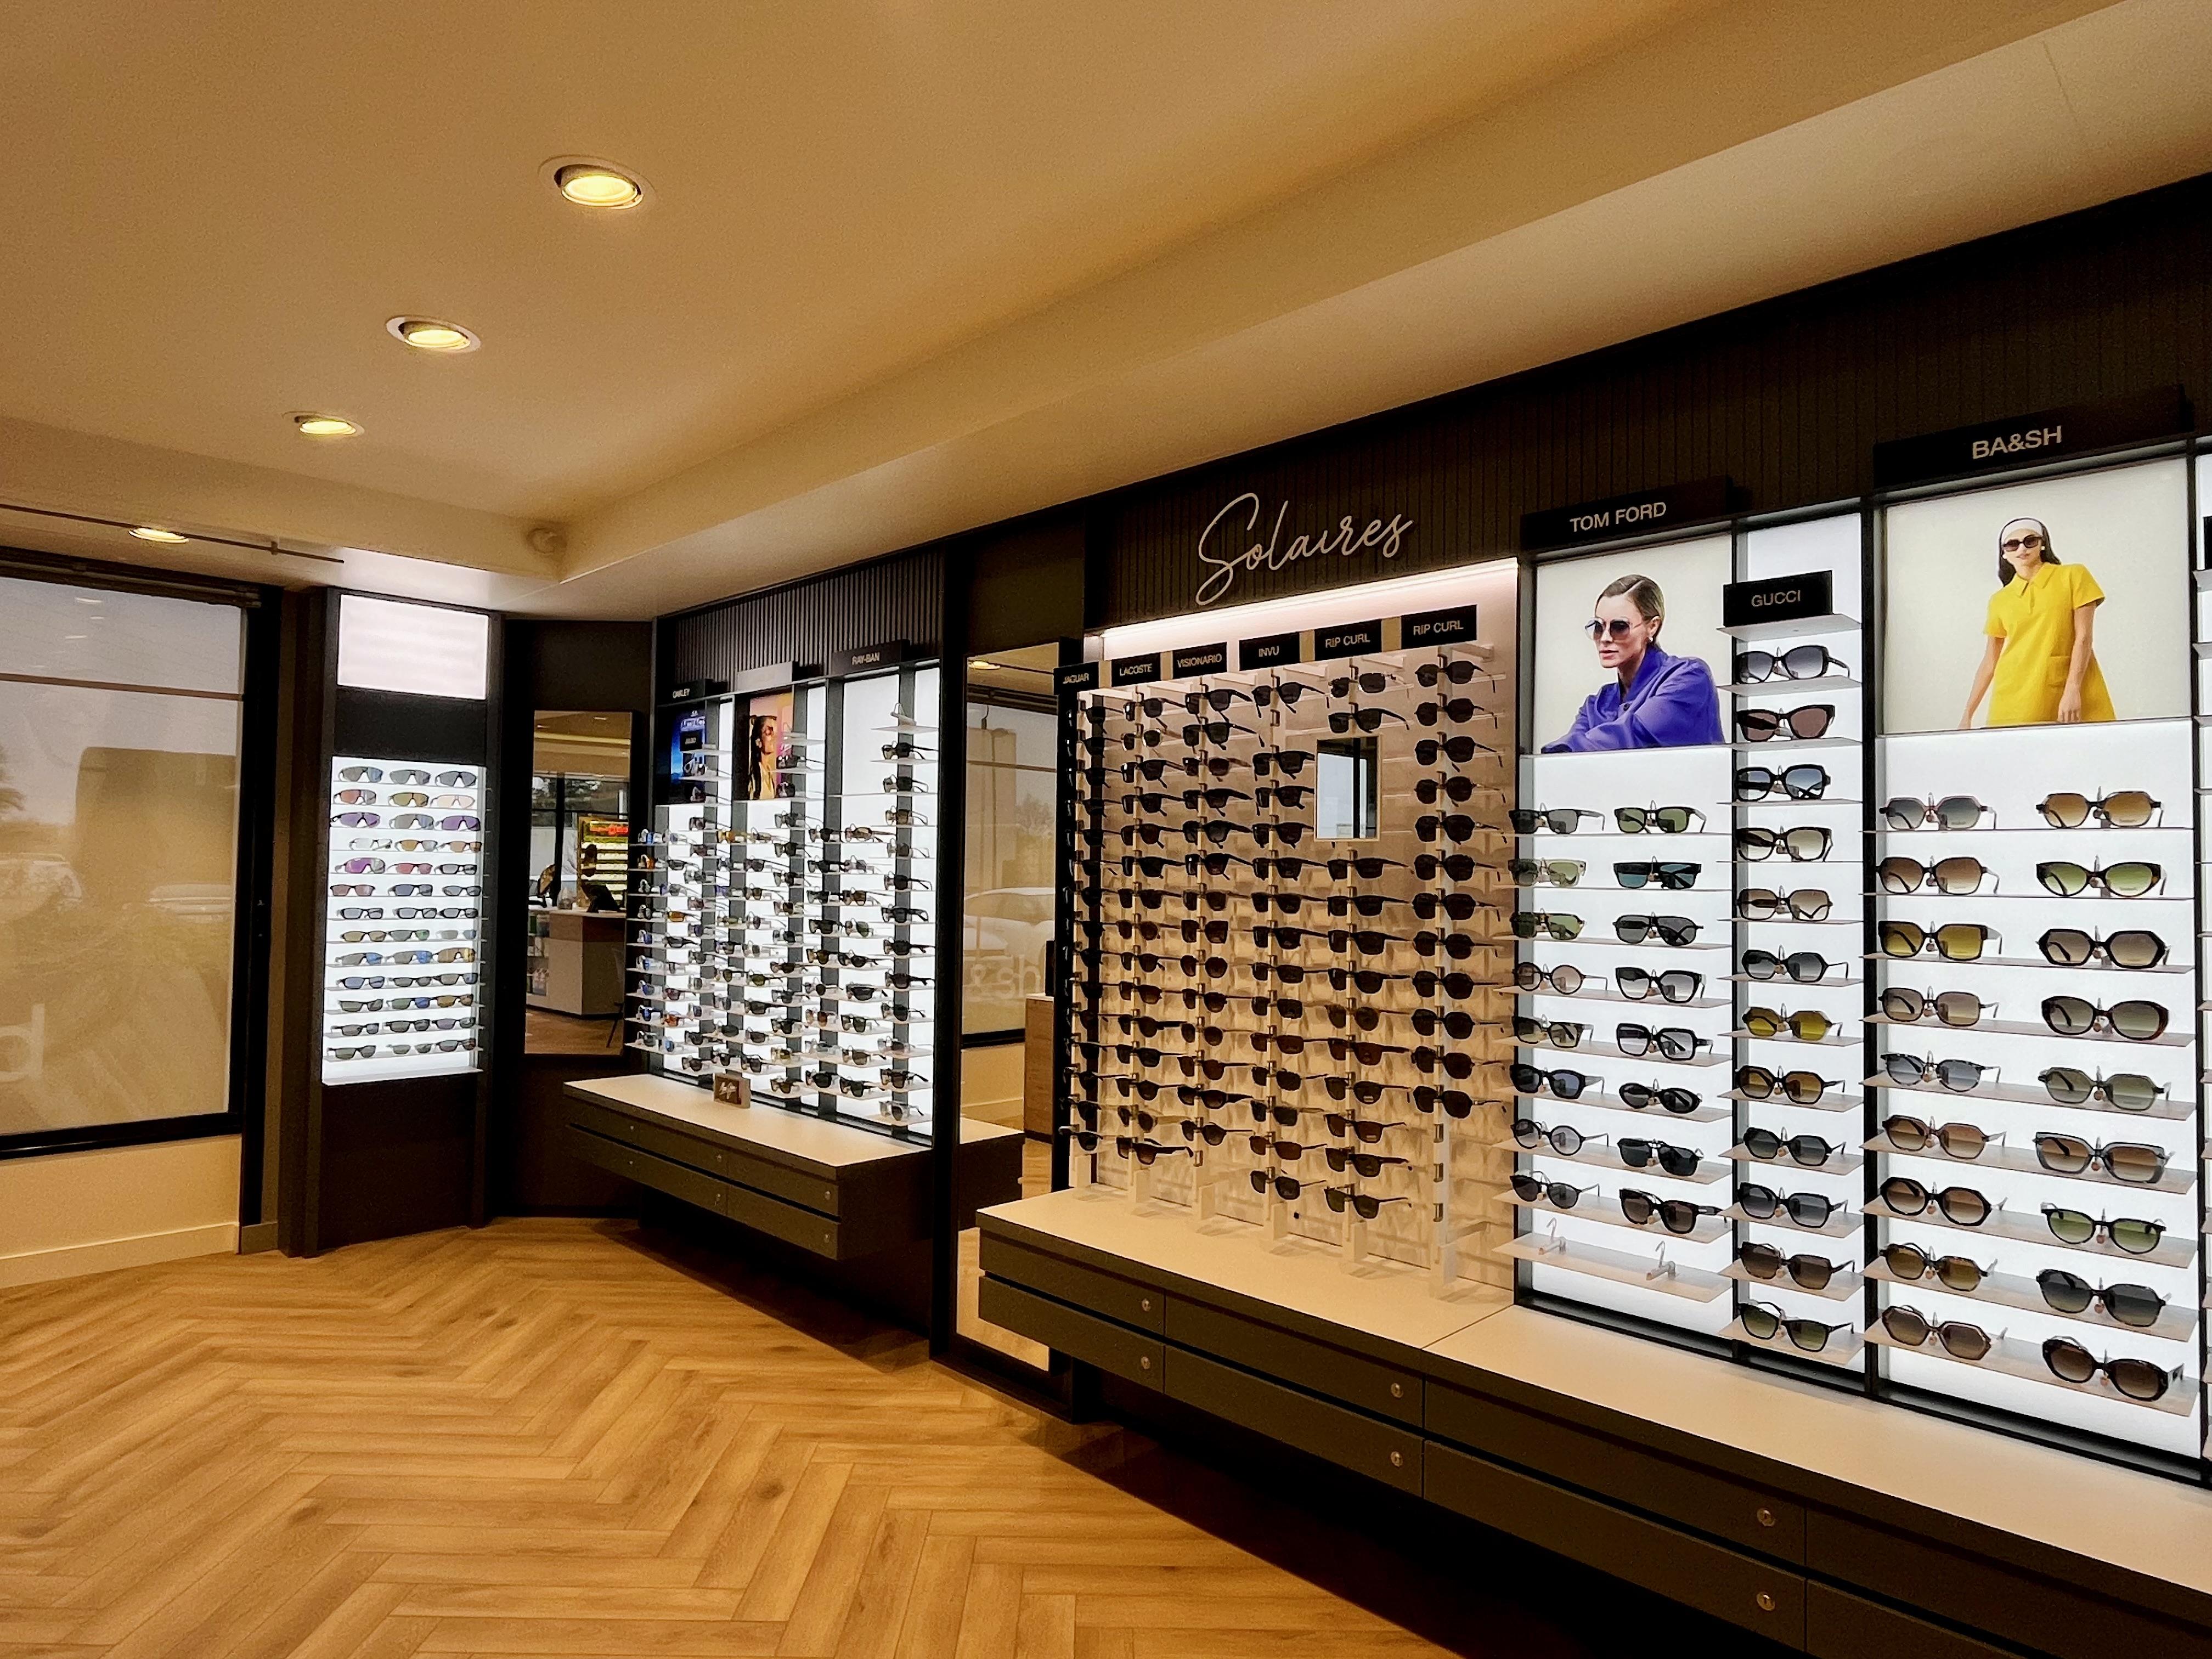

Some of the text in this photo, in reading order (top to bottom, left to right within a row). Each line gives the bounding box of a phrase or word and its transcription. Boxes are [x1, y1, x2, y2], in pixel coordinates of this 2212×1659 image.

[1972, 425, 2062, 460] BA&SH
[1570, 502, 1666, 532] TOM FORD
[1195, 493, 1413, 606] Solaires
[1751, 590, 1801, 607] GUCCI
[1413, 620, 1464, 635] RIP CURL
[1325, 633, 1370, 648] RIP CURL
[851, 652, 880, 665] RAY-BAN
[1259, 646, 1279, 657] INVU
[1177, 653, 1222, 668] VISIONARIO
[1119, 663, 1152, 676] LACOSTE
[1062, 673, 1090, 684] JAGUAR
